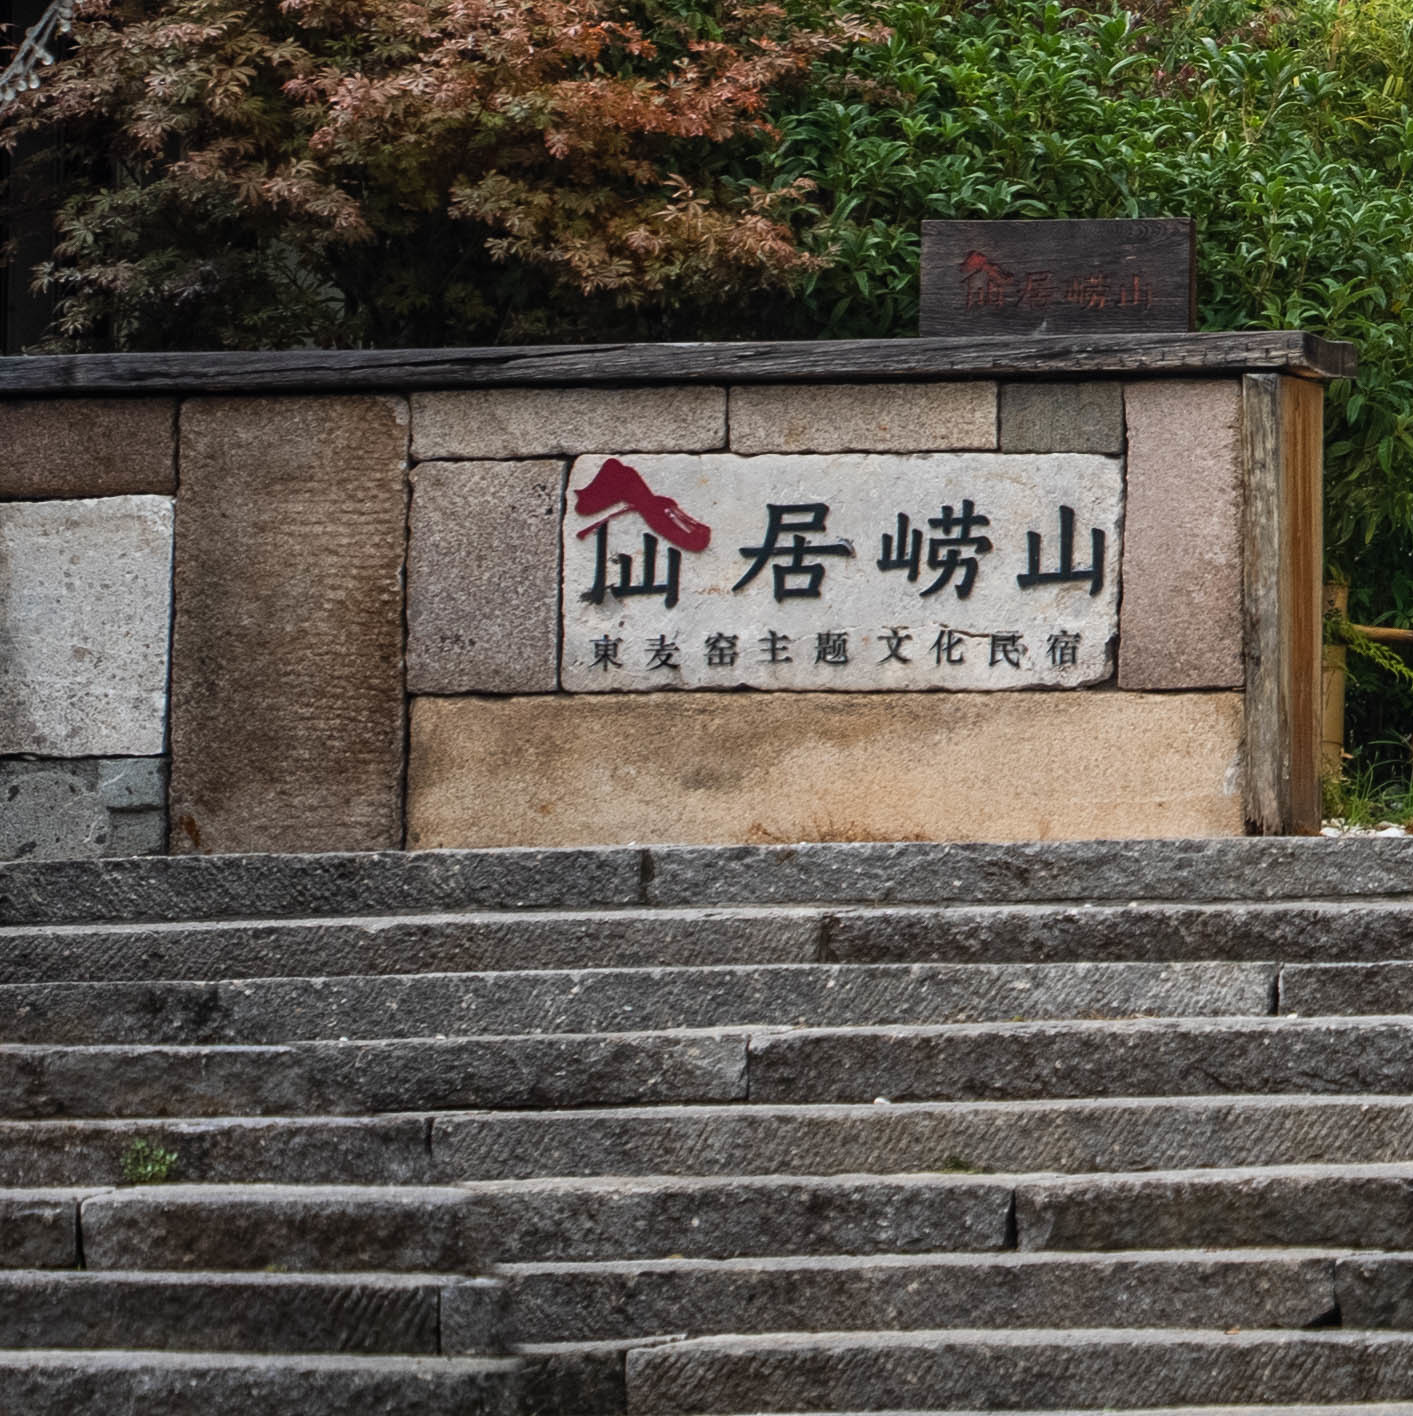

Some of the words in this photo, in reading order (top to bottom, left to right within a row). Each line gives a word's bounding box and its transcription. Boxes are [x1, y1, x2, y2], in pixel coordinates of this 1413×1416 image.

[574, 458, 1107, 609] 仙居崂山
[587, 626, 1081, 672] 東麦窑主题文化民宿
